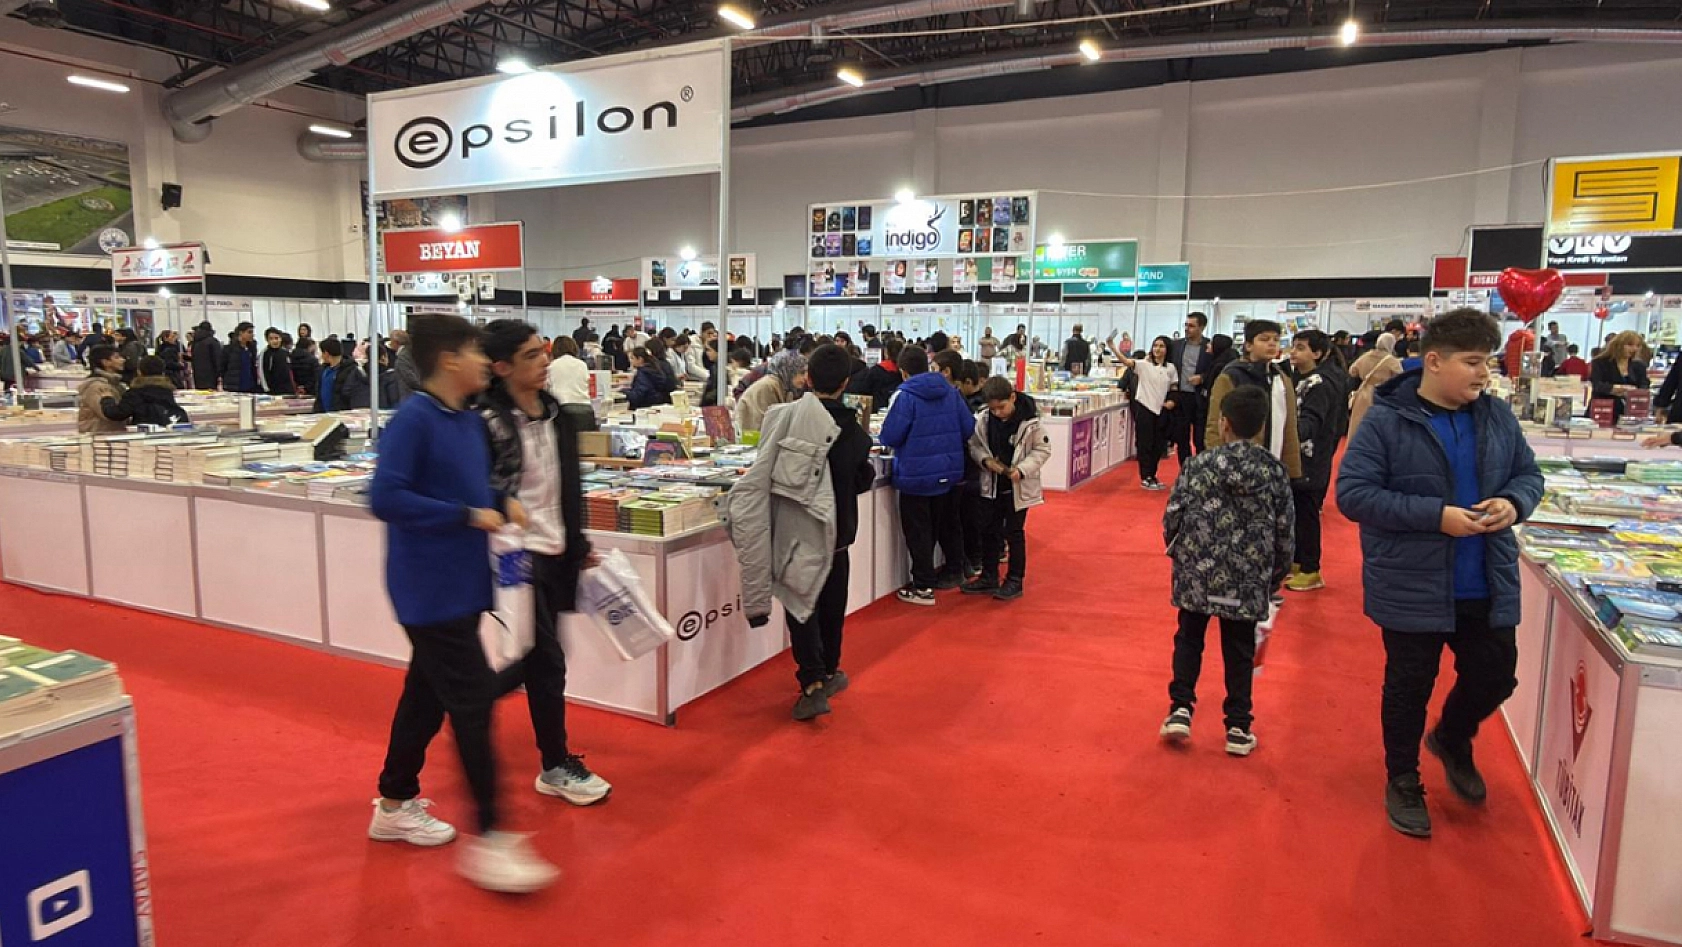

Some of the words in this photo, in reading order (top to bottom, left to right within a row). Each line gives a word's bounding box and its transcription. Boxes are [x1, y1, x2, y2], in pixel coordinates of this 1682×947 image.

[419, 240, 481, 260] BEYAN
[885, 229, 938, 251] indigo
[676, 594, 741, 641] epsi
